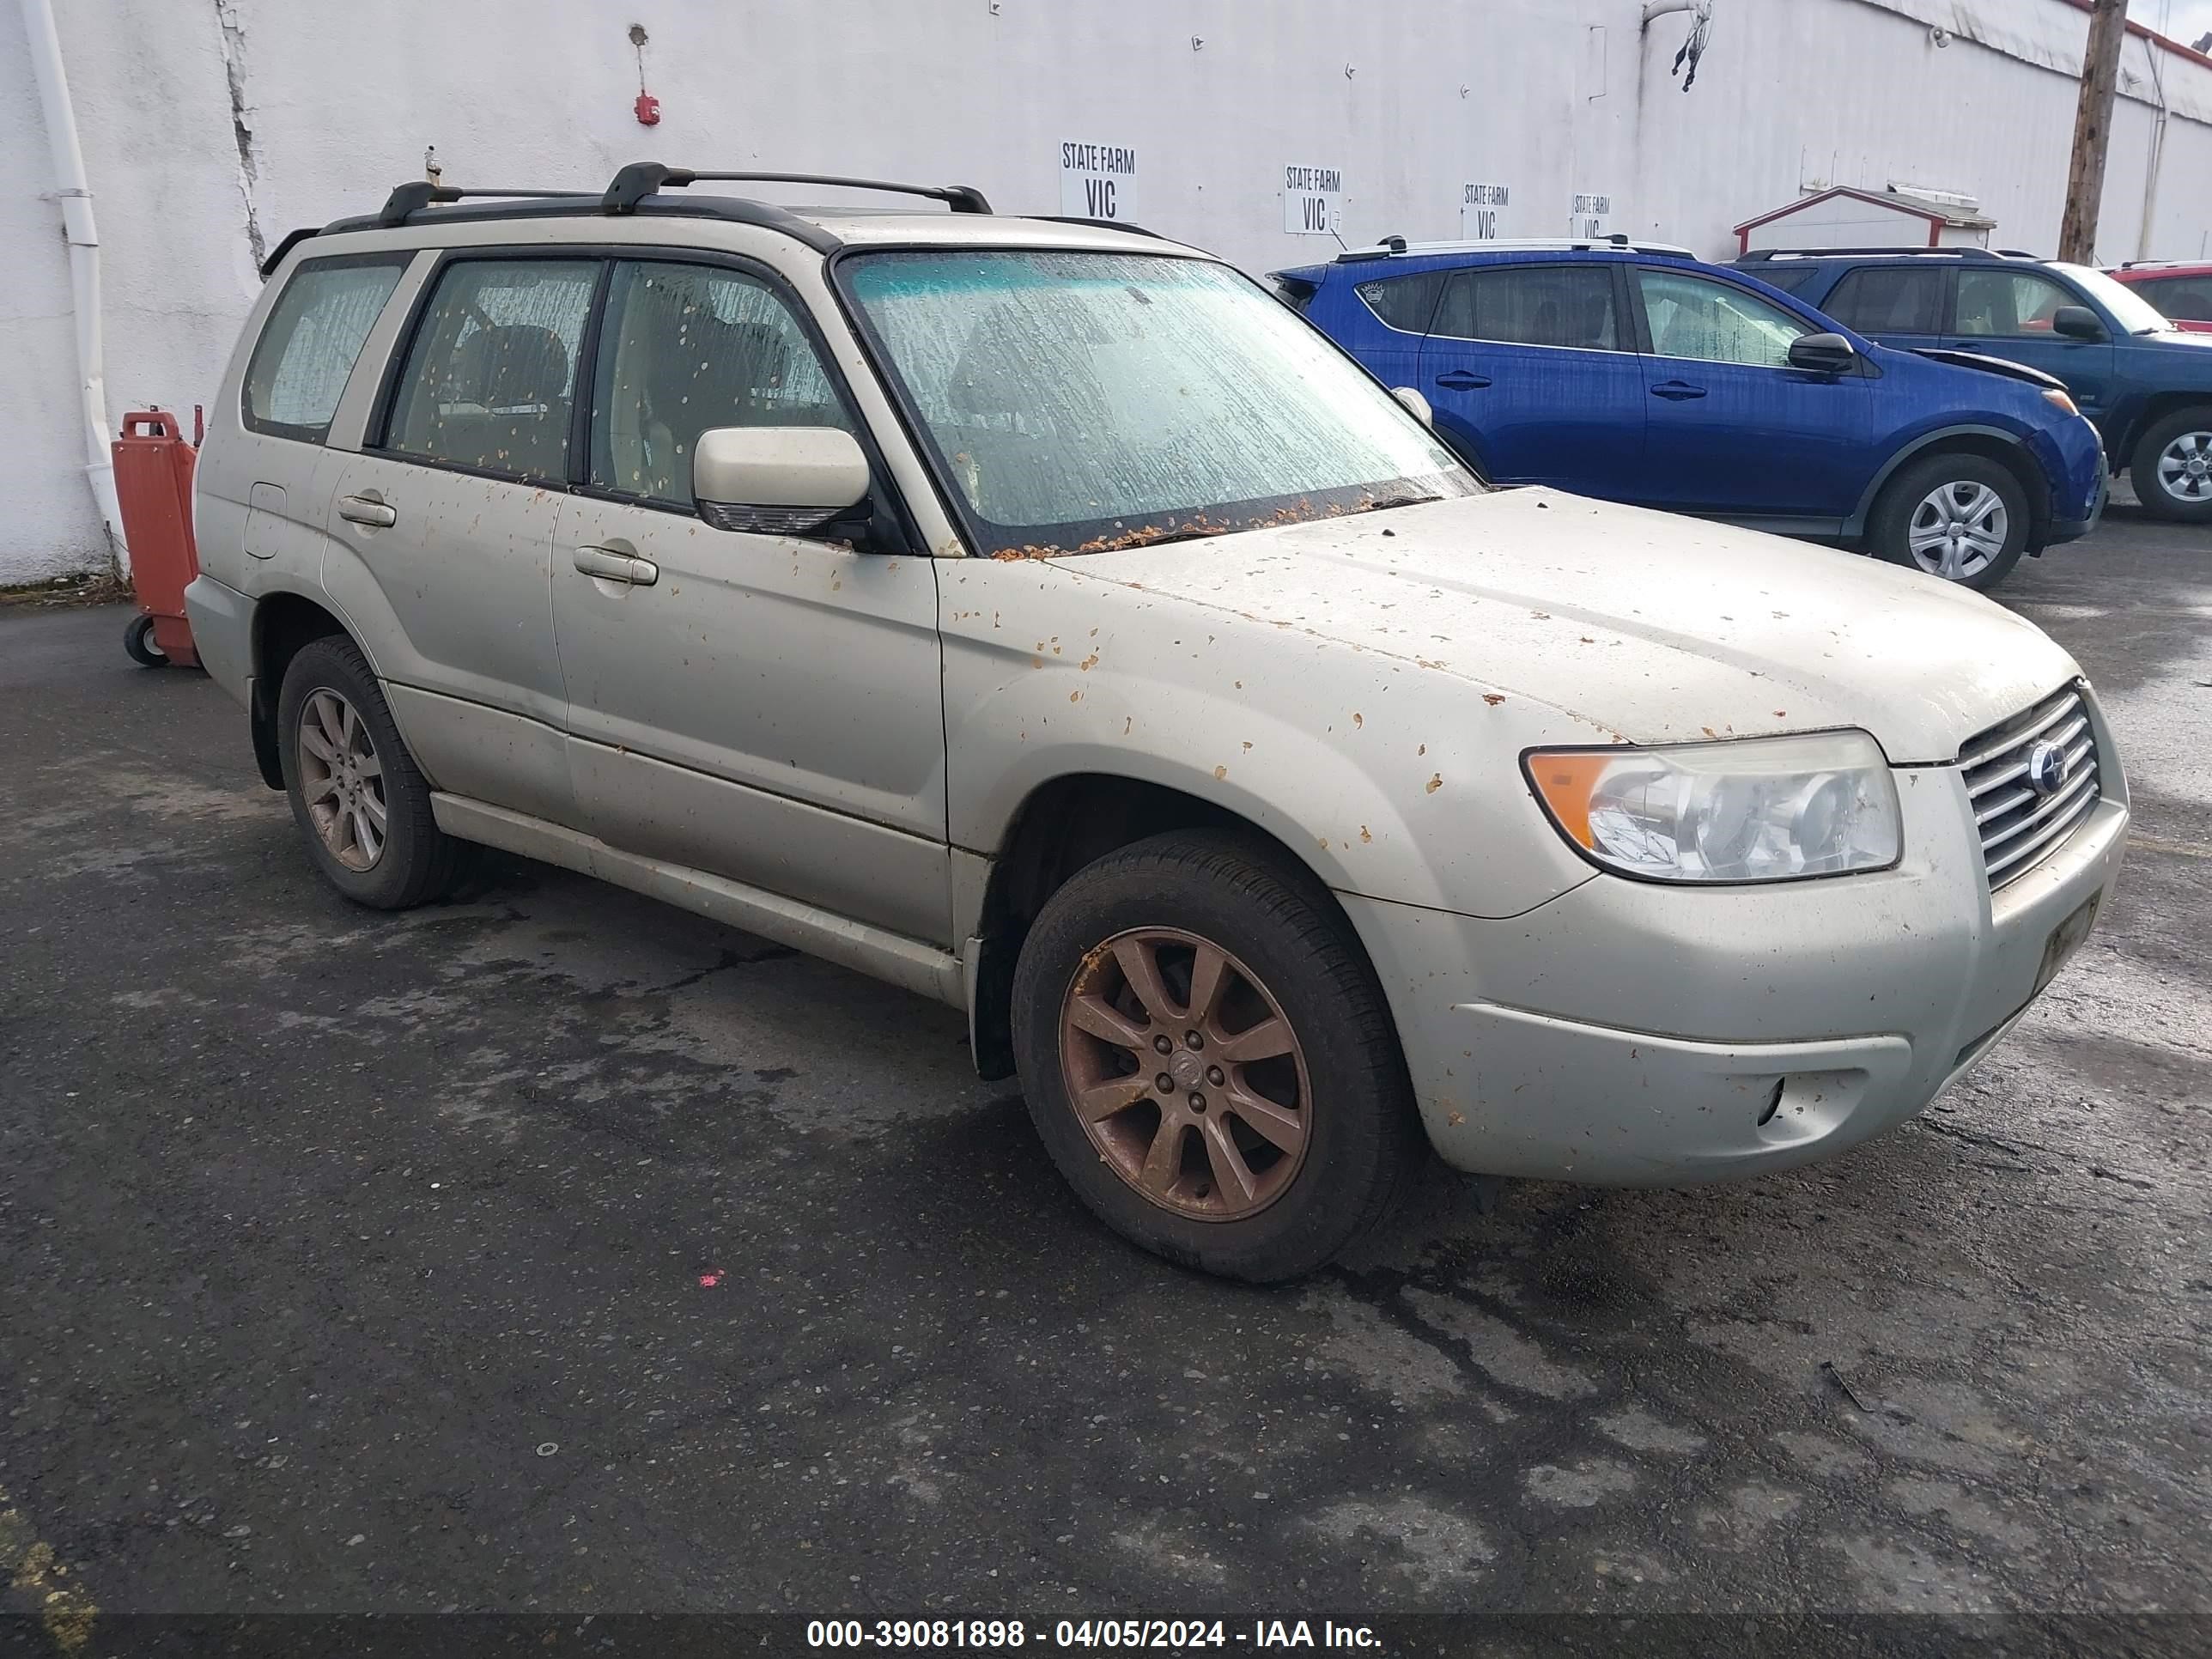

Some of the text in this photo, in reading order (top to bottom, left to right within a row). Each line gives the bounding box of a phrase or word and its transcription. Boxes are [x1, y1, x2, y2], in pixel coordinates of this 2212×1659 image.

[1062, 142, 1135, 174] STATE FARM
[1286, 166, 1340, 192] STATE FARM
[1085, 179, 1115, 218] VIC
[1465, 184, 1509, 206] STATE FARM
[1575, 195, 1610, 214] STATE FARM
[1303, 197, 1325, 231] VIC
[1478, 210, 1495, 240] VIC
[1585, 219, 1599, 239] VIC
